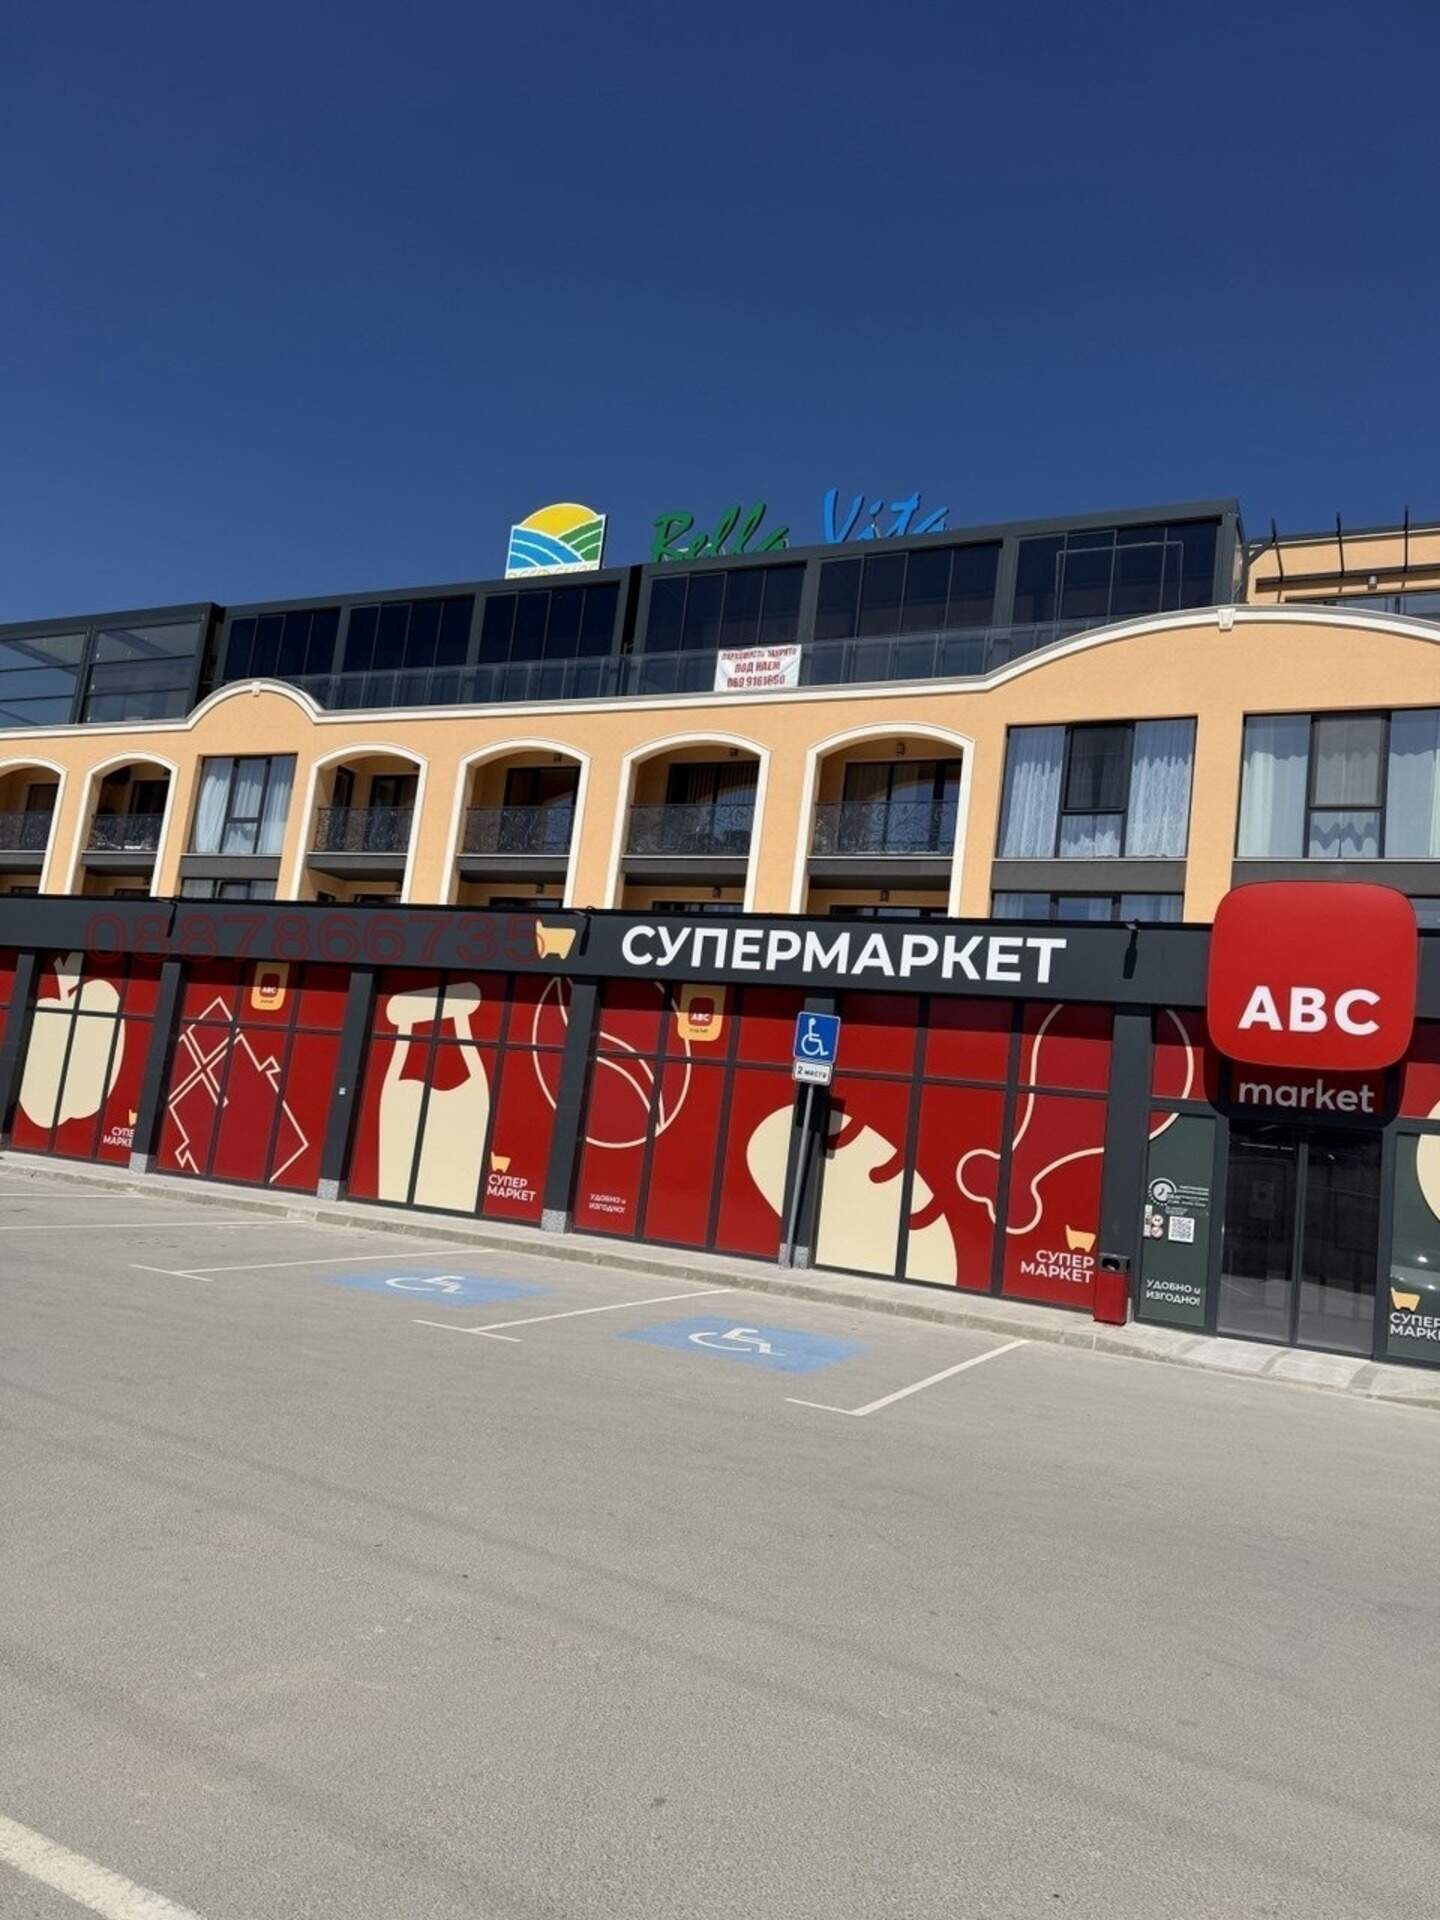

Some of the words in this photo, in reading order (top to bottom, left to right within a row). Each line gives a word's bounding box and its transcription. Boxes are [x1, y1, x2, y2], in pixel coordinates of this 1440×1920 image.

[622, 925, 1067, 983] СУПЕРМАРКЕТ
[1237, 985, 1381, 1036] ABC
[798, 1065, 803, 1074] 2
[1238, 1078, 1375, 1113] market
[111, 1126, 135, 1138] СУПЕ
[488, 1174, 528, 1189] СУПЕР
[487, 1184, 537, 1202] МАРКЕТ
[1035, 1249, 1095, 1269] СУПЕР
[1020, 1260, 1094, 1283] МАРКЕТ
[1146, 1279, 1192, 1294] УДОБНО
